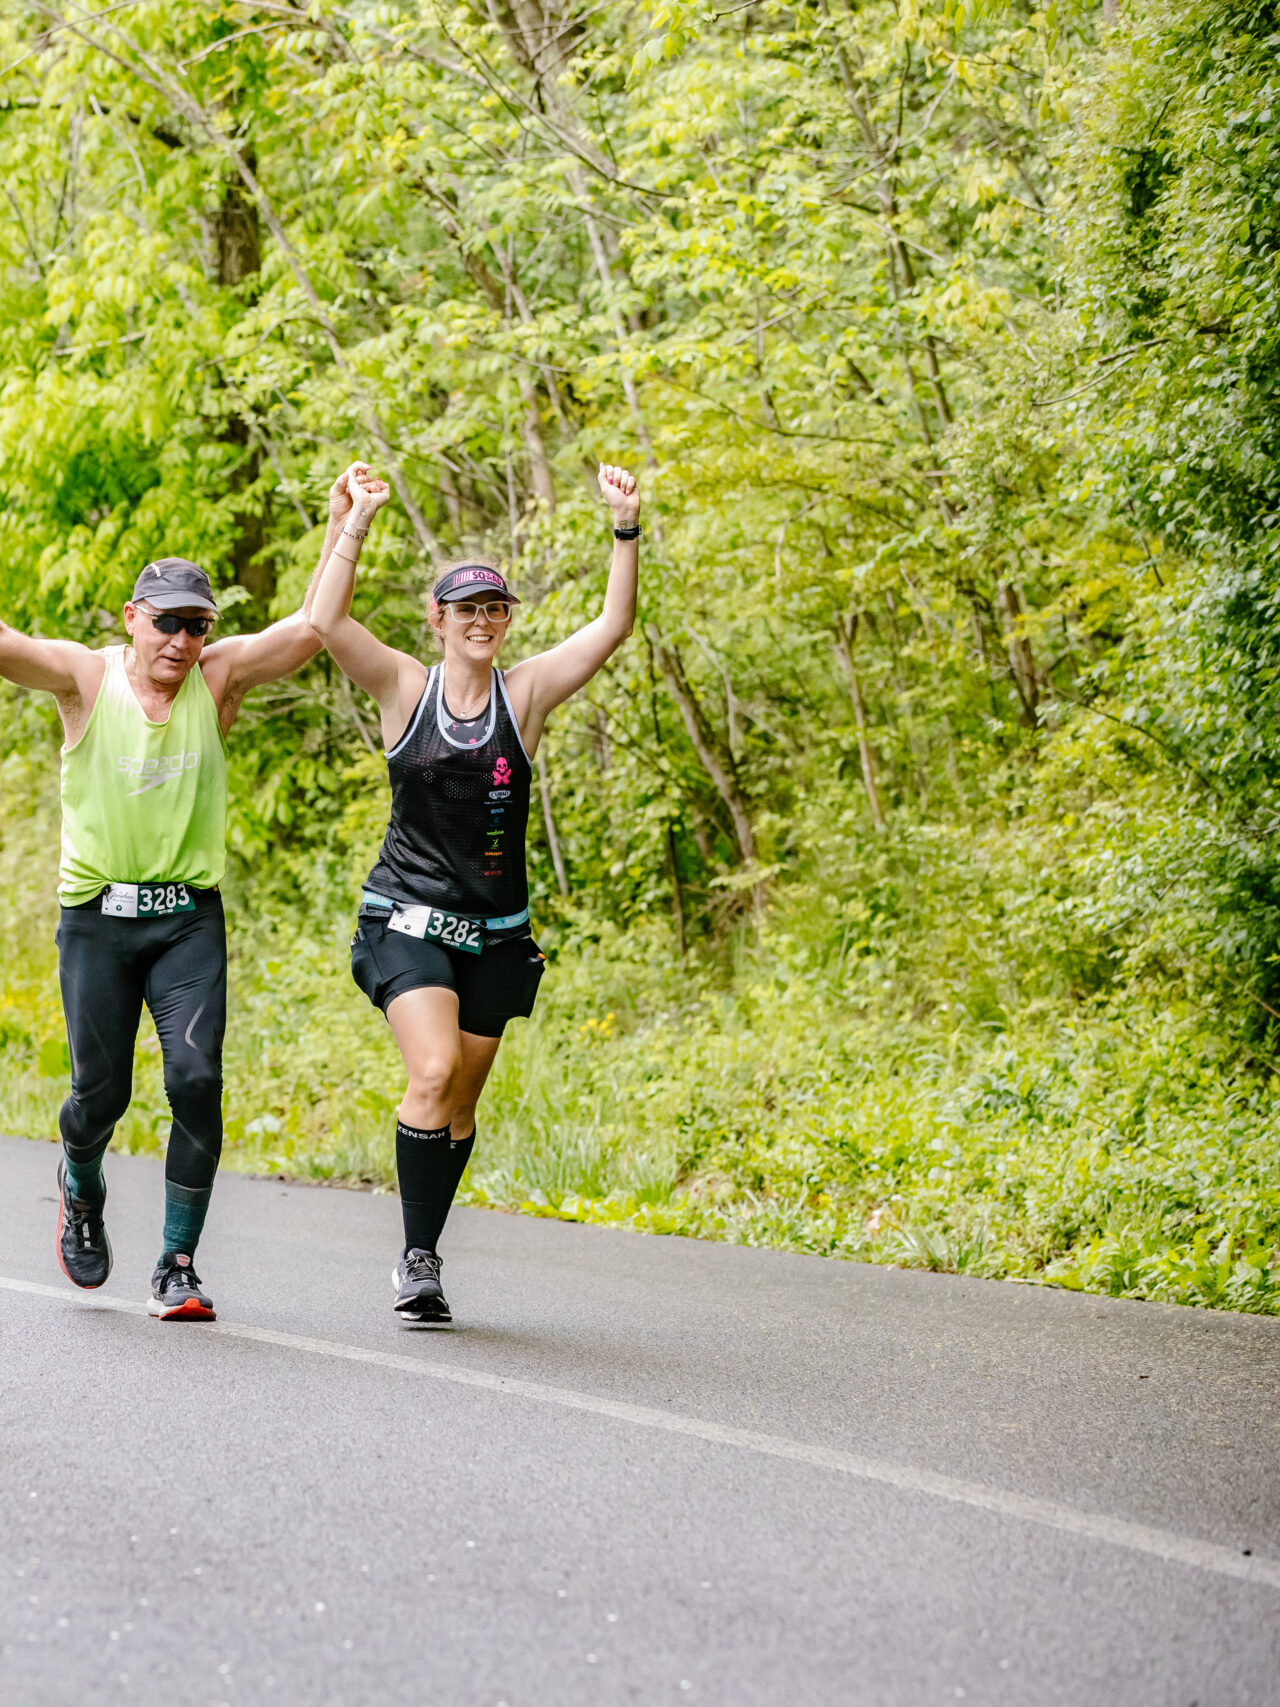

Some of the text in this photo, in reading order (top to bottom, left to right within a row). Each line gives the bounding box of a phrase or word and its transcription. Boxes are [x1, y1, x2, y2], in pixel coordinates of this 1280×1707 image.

[117, 749, 198, 777] speedo
[138, 883, 190, 911] 3283
[427, 912, 481, 948] 3282
[397, 1124, 445, 1140] ZENSAH
